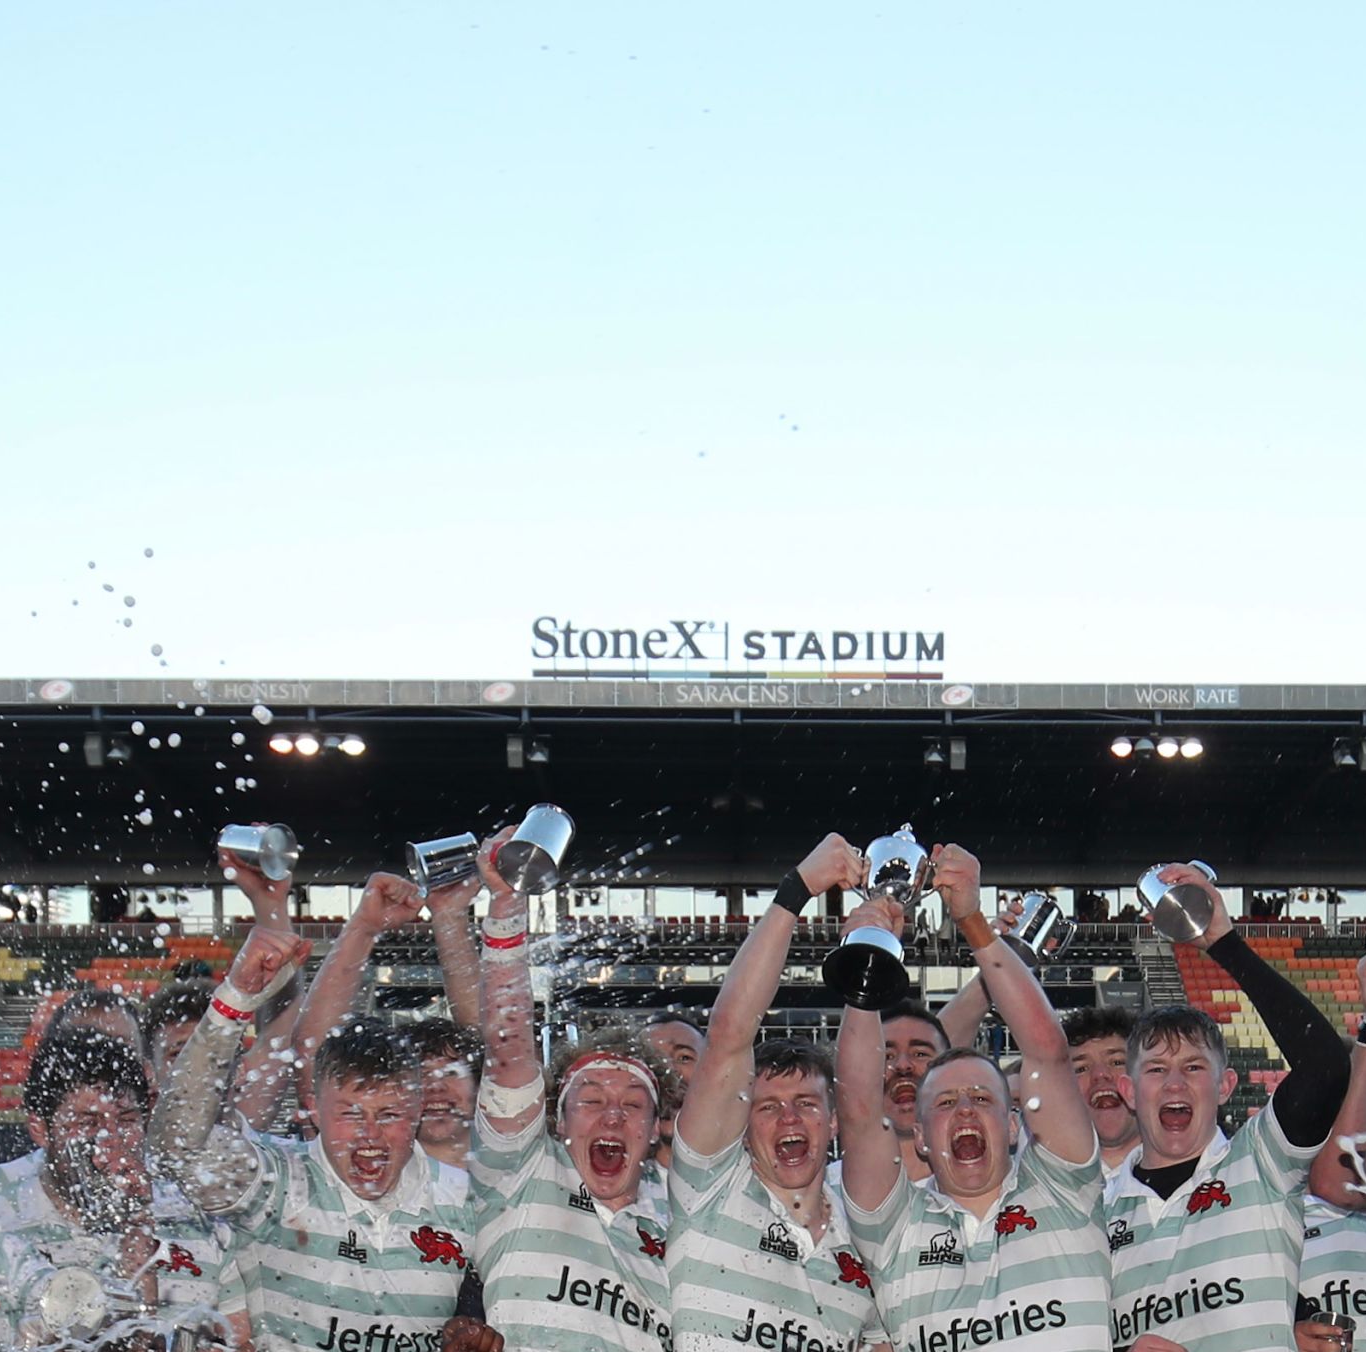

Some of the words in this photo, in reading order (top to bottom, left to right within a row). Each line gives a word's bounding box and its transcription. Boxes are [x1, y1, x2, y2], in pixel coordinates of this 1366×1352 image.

[743, 630, 945, 661] STADIUM
[224, 682, 312, 699] HONESTY
[676, 684, 789, 704] SARACENS
[1135, 688, 1190, 704] WORK
[1196, 688, 1237, 704] RATE
[1111, 1276, 1245, 1344] Jefferies
